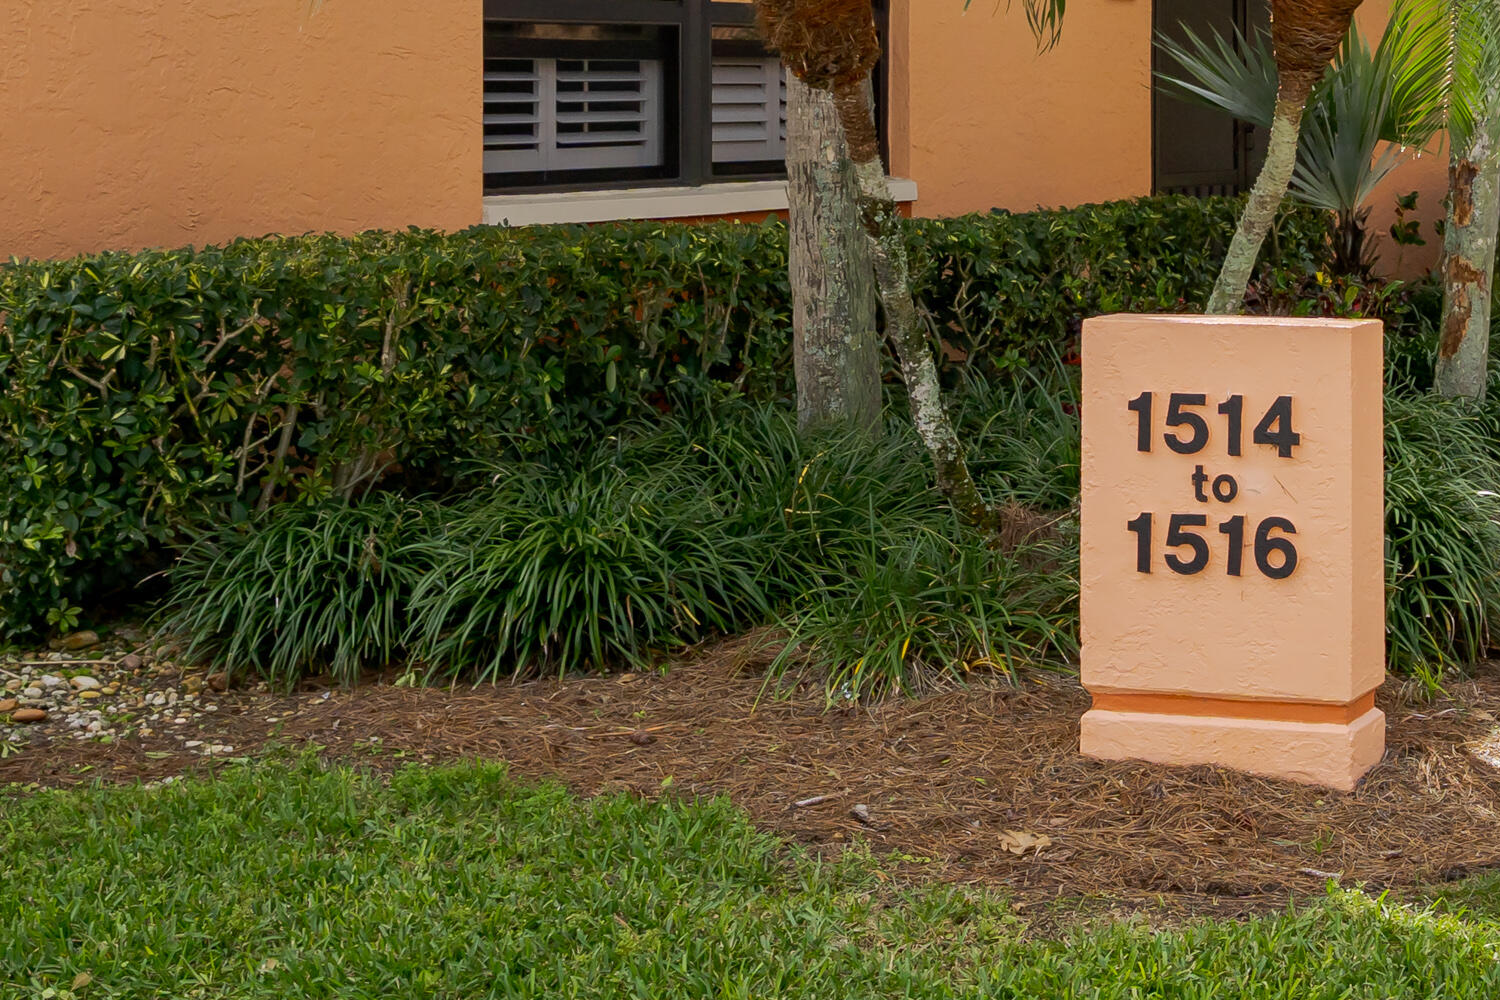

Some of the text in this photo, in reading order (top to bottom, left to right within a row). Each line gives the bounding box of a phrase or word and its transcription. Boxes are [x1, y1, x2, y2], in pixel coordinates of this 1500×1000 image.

[1127, 391, 1300, 458] 1514
[1191, 464, 1239, 503] to
[1127, 512, 1299, 579] 1516
